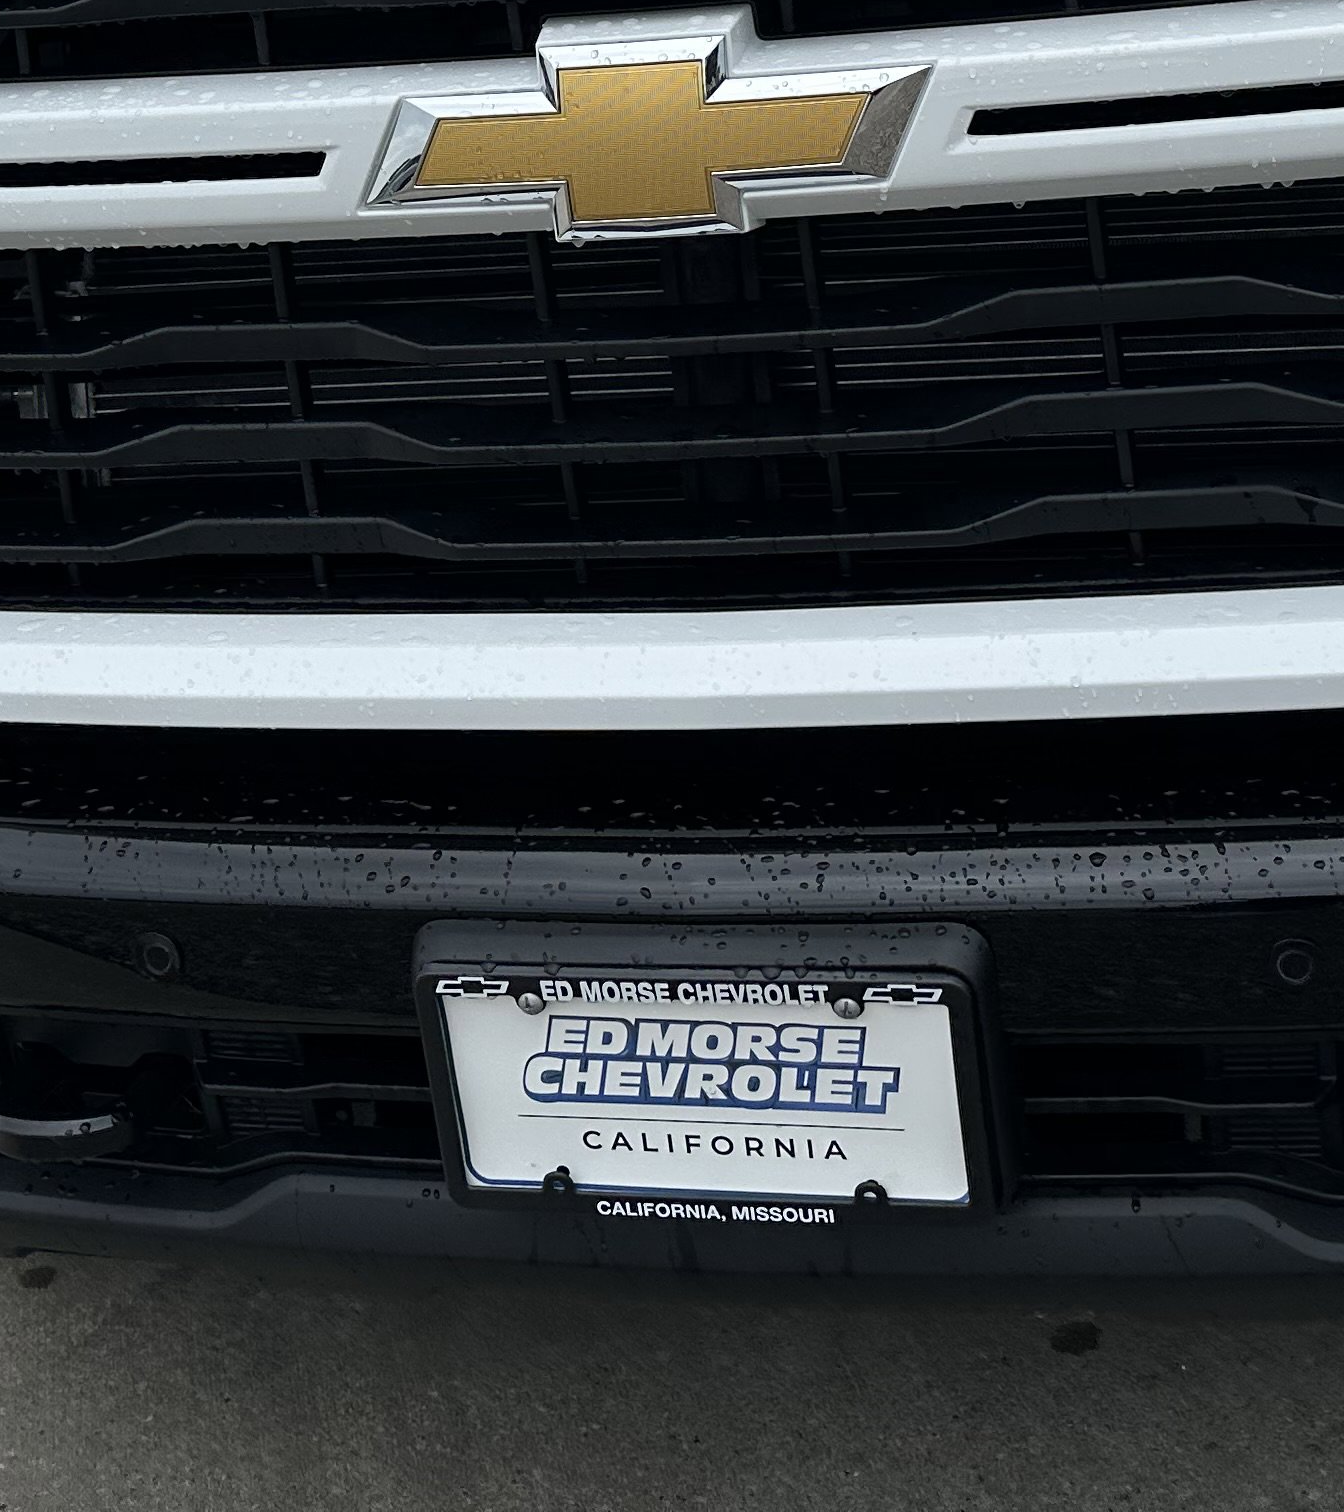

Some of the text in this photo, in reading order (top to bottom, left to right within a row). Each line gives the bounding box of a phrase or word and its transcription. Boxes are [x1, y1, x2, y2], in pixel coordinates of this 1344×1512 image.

[539, 979, 829, 1007] ED MORSE CHEVROLET
[547, 1015, 866, 1065] ED MORSE
[524, 1053, 901, 1112] CHEVROLET
[582, 1130, 849, 1160] CALIFORNIA
[596, 1199, 836, 1224] CALIFORNIA, MISSOURI
